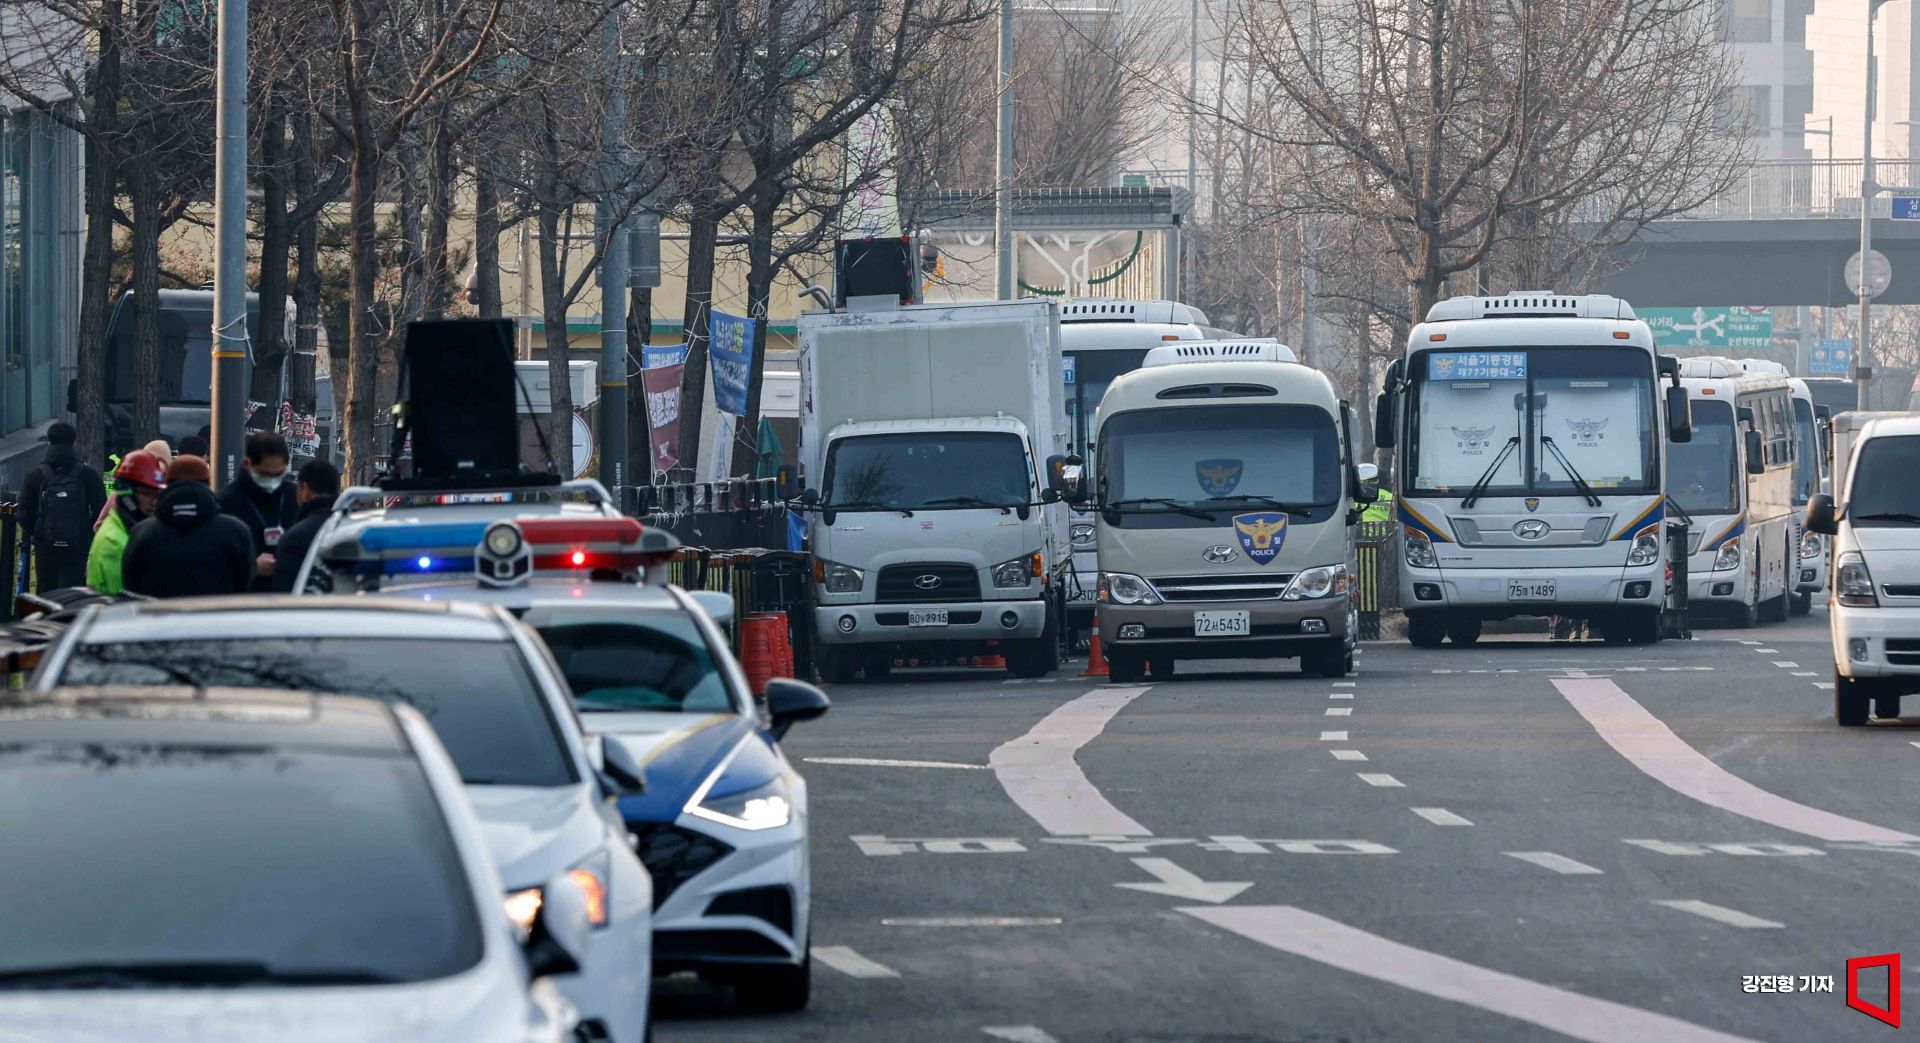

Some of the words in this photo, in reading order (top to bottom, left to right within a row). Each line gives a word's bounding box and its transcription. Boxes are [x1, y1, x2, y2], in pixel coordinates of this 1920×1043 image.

[1456, 354, 1524, 366] 서울기동경찰
[1456, 367, 1524, 377] 제77기동대-2
[1250, 548, 1275, 556] POLICE
[1196, 618, 1247, 632] 72서5431
